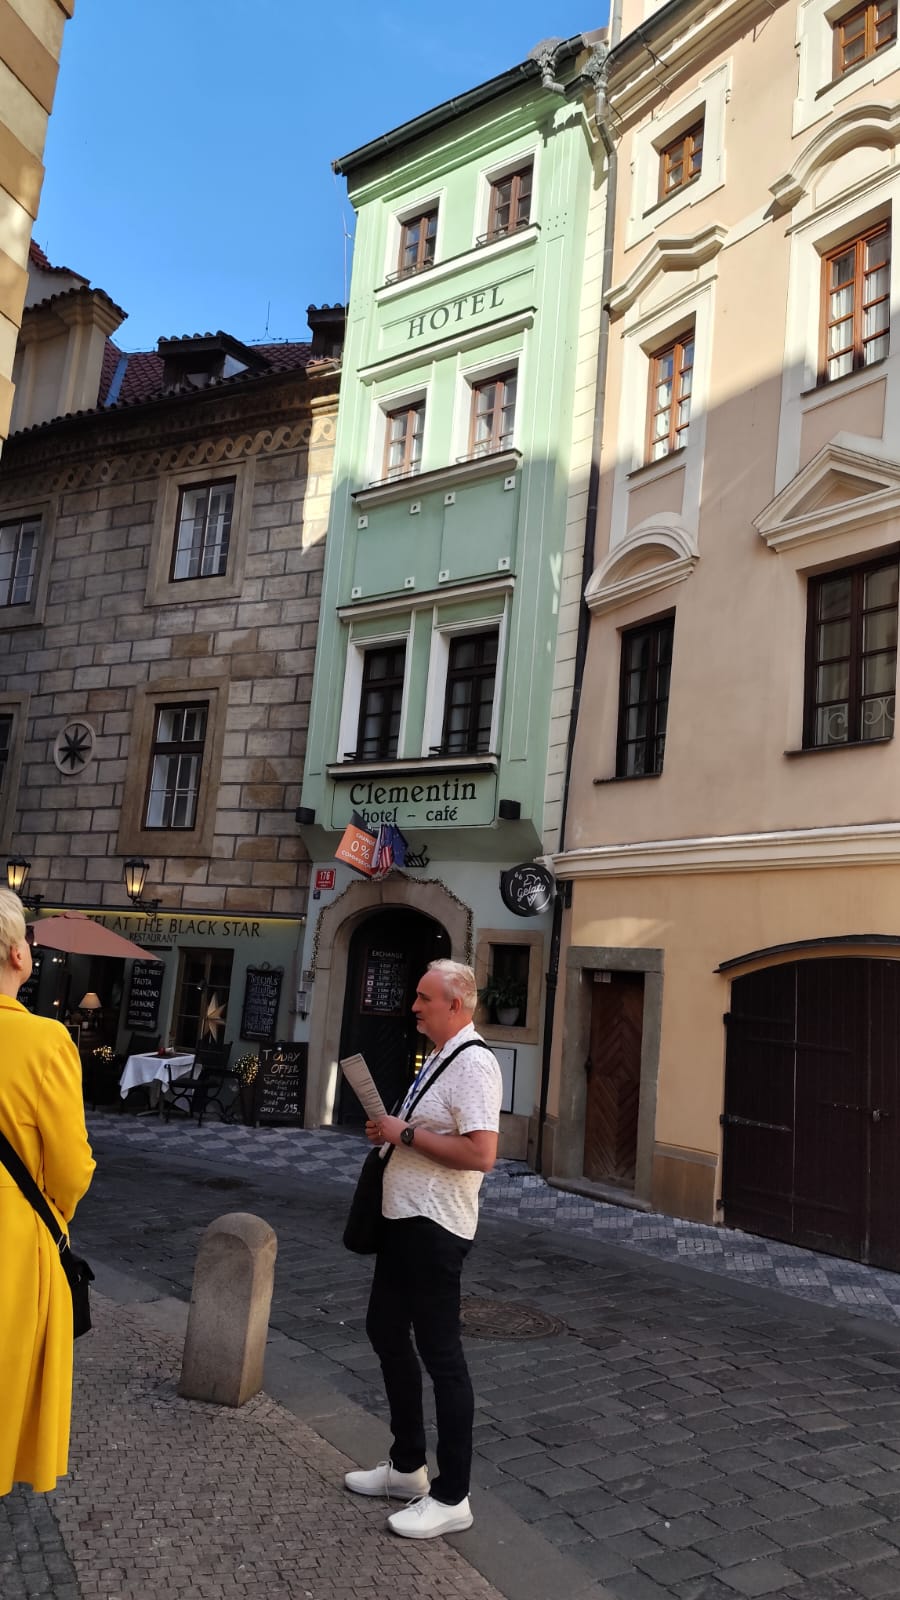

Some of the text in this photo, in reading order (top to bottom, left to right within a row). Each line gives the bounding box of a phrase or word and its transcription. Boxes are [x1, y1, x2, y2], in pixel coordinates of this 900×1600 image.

[407, 286, 504, 340] HOTEL
[349, 778, 477, 805] Clementin
[361, 806, 398, 823] hotel
[425, 805, 458, 821] café
[517, 882, 546, 902] Gelato
[112, 916, 132, 930] AT
[136, 917, 163, 933] THE
[169, 919, 217, 935] BLACK
[222, 921, 260, 936] STAR
[129, 932, 178, 944] RESTAURANT
[262, 1049, 301, 1061] TODAY
[270, 1063, 299, 1074] OFFER
